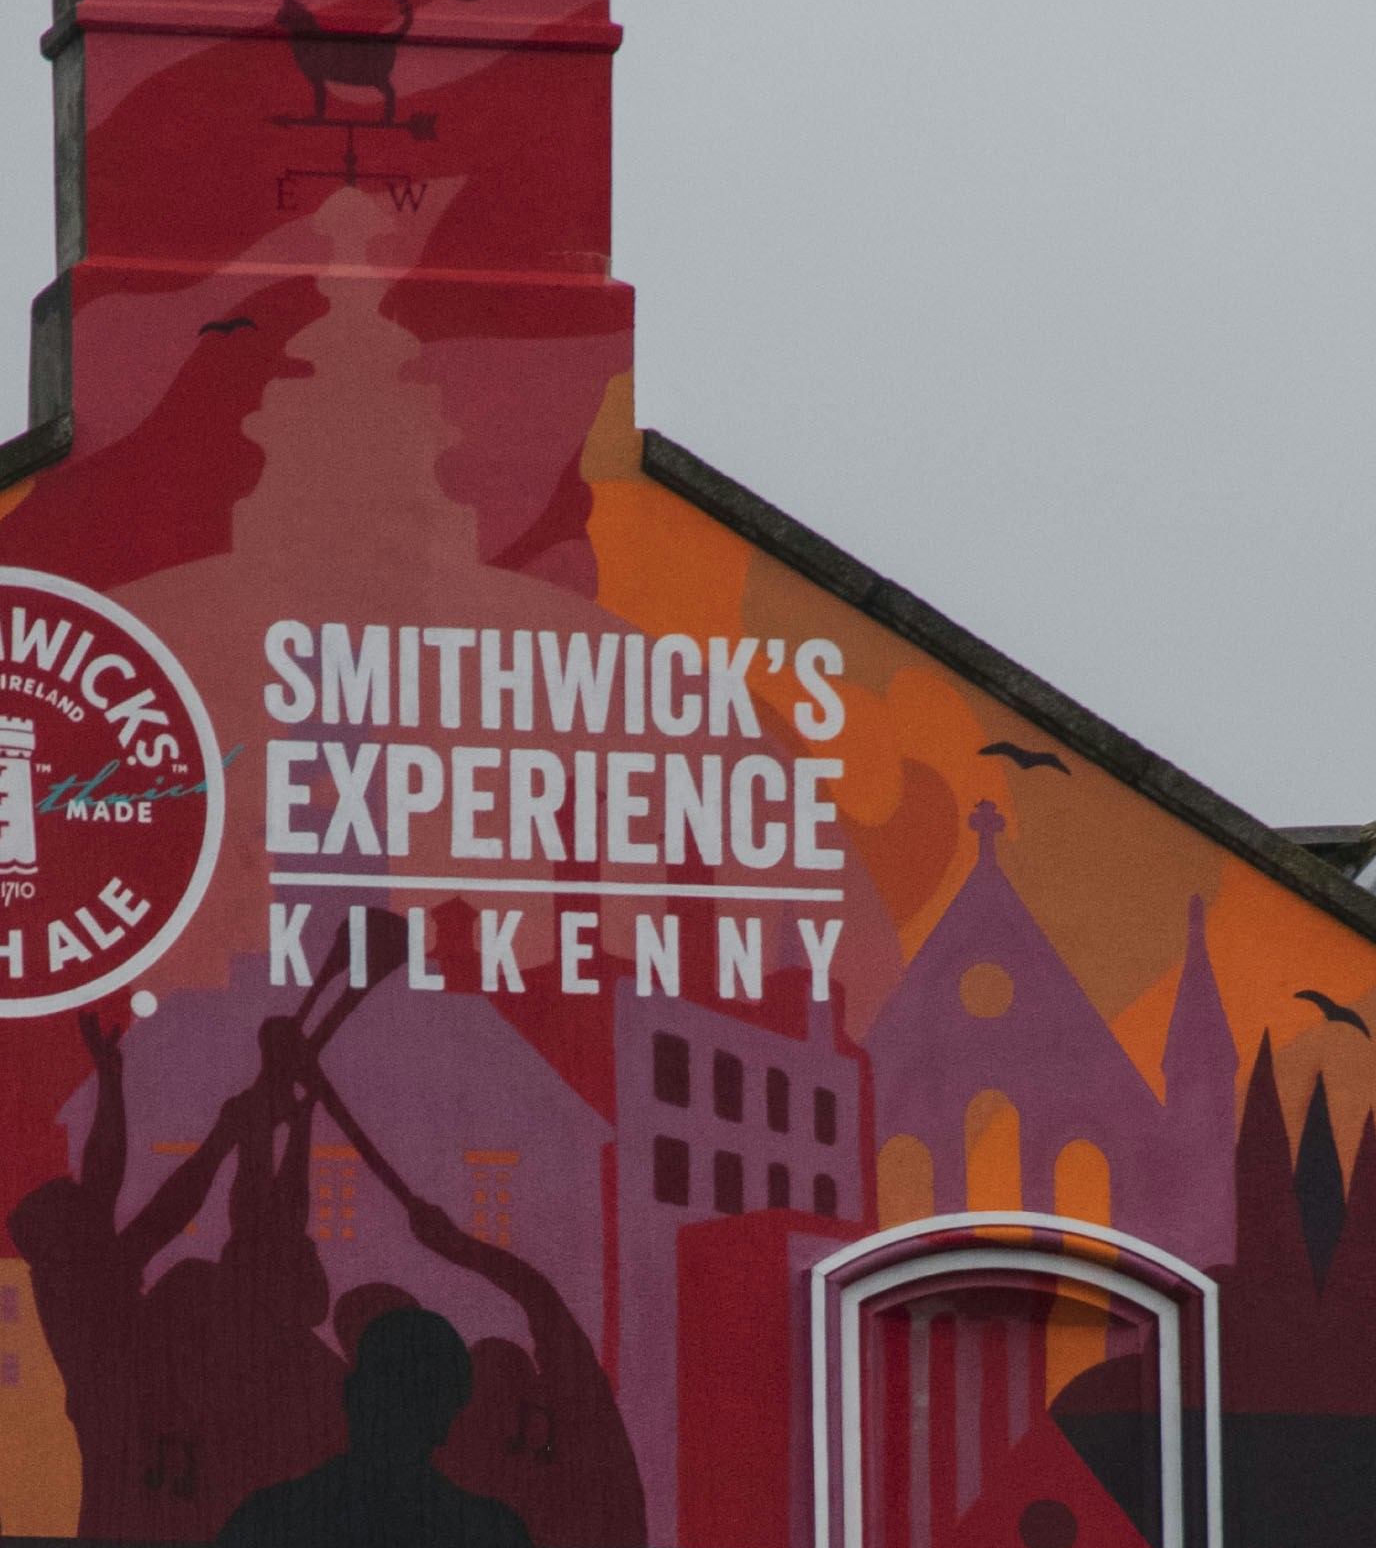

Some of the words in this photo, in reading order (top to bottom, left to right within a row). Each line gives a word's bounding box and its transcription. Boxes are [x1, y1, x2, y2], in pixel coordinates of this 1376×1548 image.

[276, 177, 297, 210] E
[386, 182, 428, 212] W
[0, 674, 85, 724] IRELAND
[263, 619, 846, 742] SMITHWICK'S
[66, 800, 153, 824] MADE
[265, 739, 845, 871] EXPERIENCE
[0, 881, 36, 907] 1710
[46, 877, 151, 973] ALE
[268, 902, 844, 1002] KILKENNY
